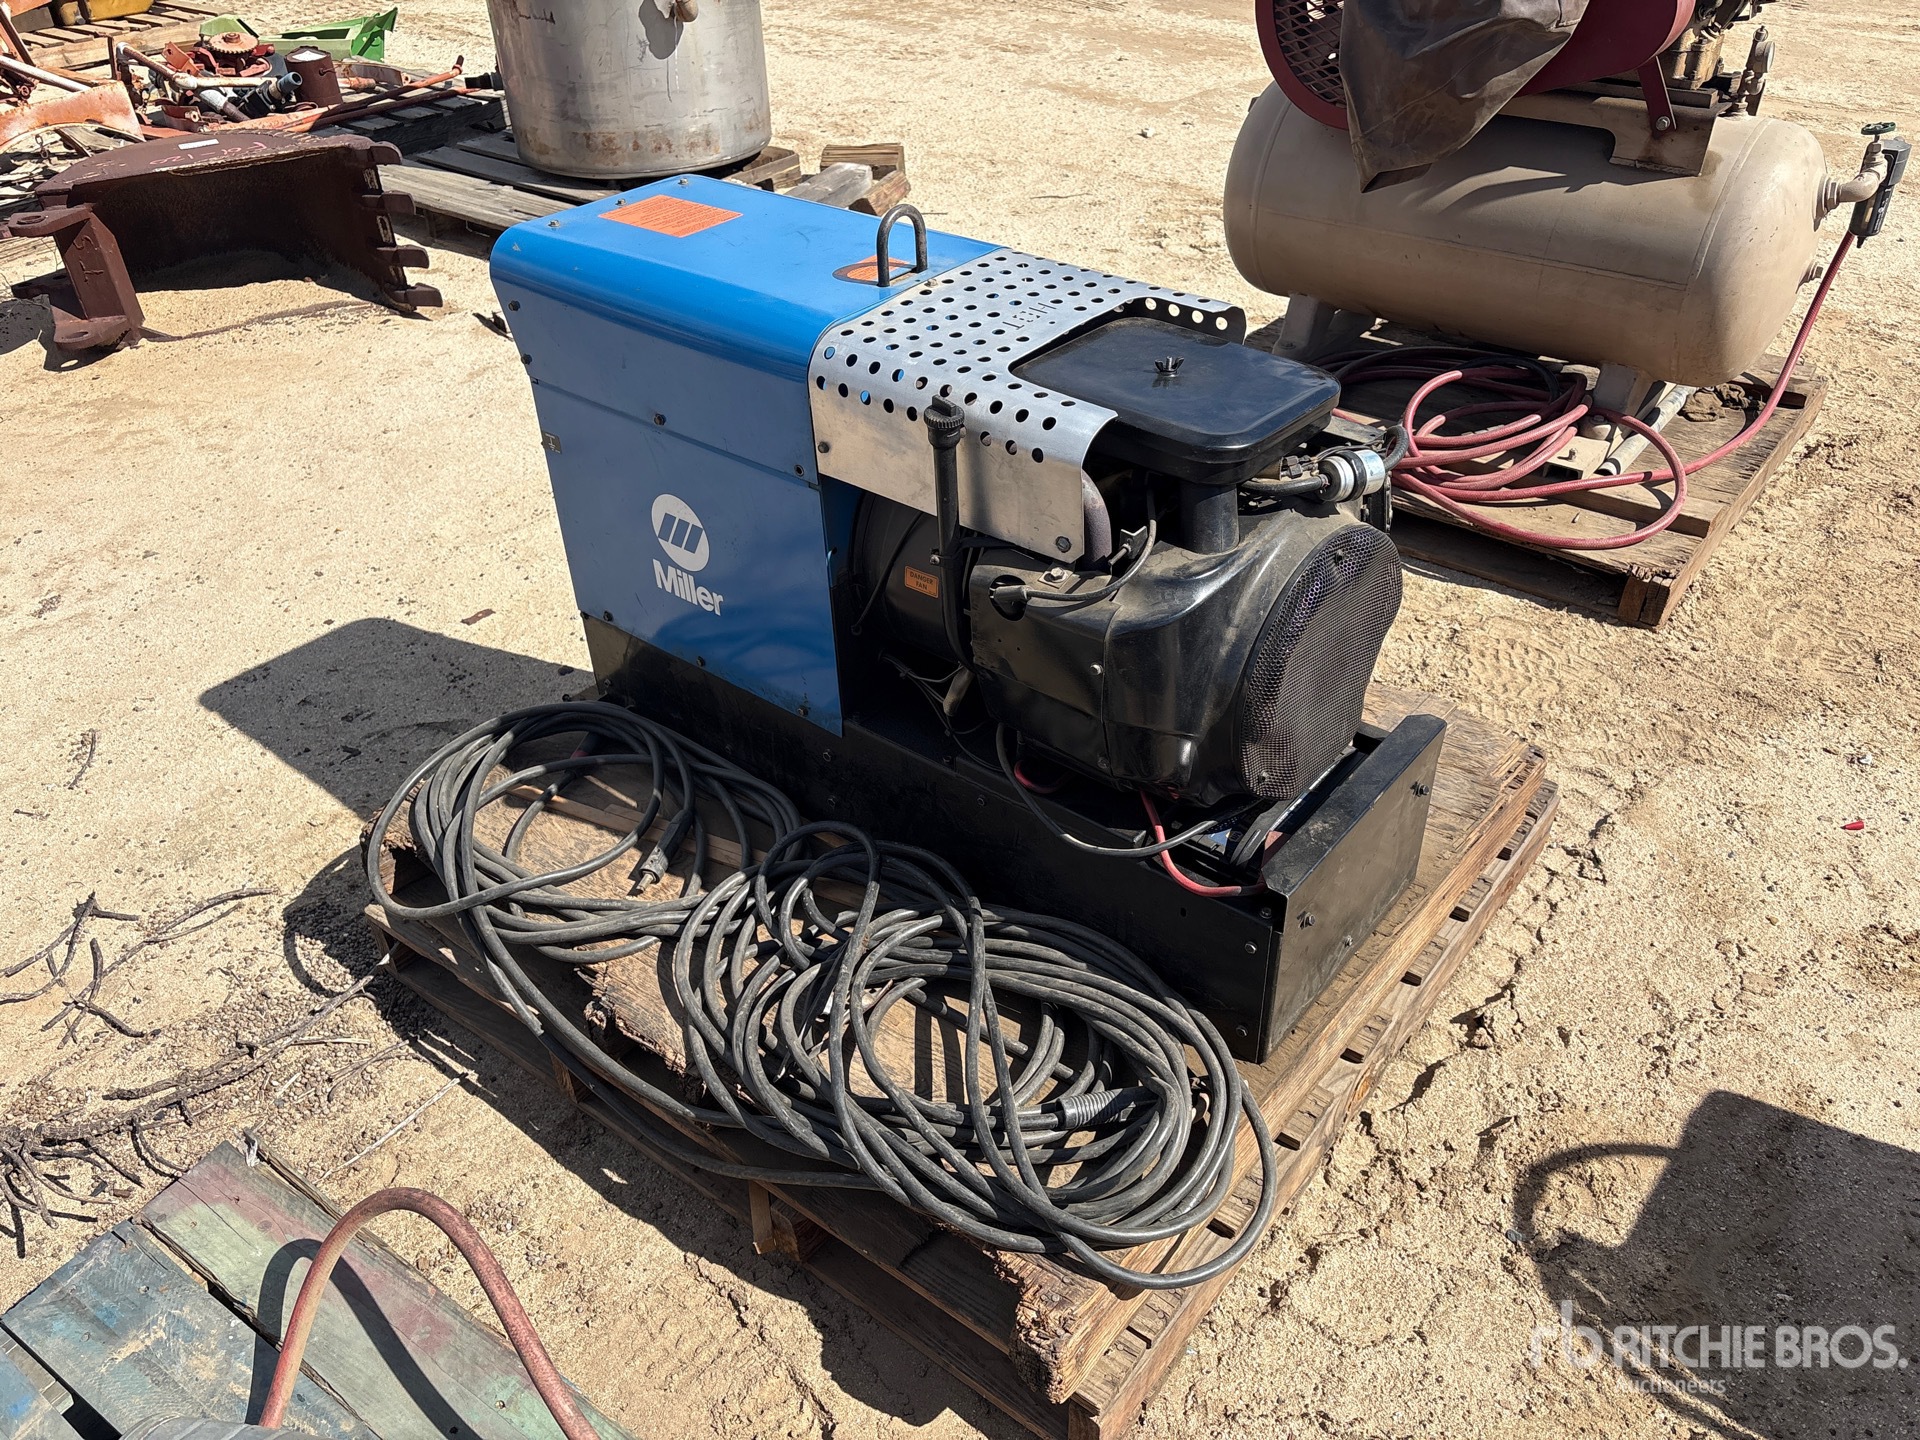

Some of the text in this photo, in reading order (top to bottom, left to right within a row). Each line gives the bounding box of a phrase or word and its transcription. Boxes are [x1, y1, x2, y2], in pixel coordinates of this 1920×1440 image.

[1002, 302, 1057, 331] HOT
[652, 558, 724, 616] Miller
[909, 571, 934, 585] DANGER
[915, 581, 928, 591] FAN
